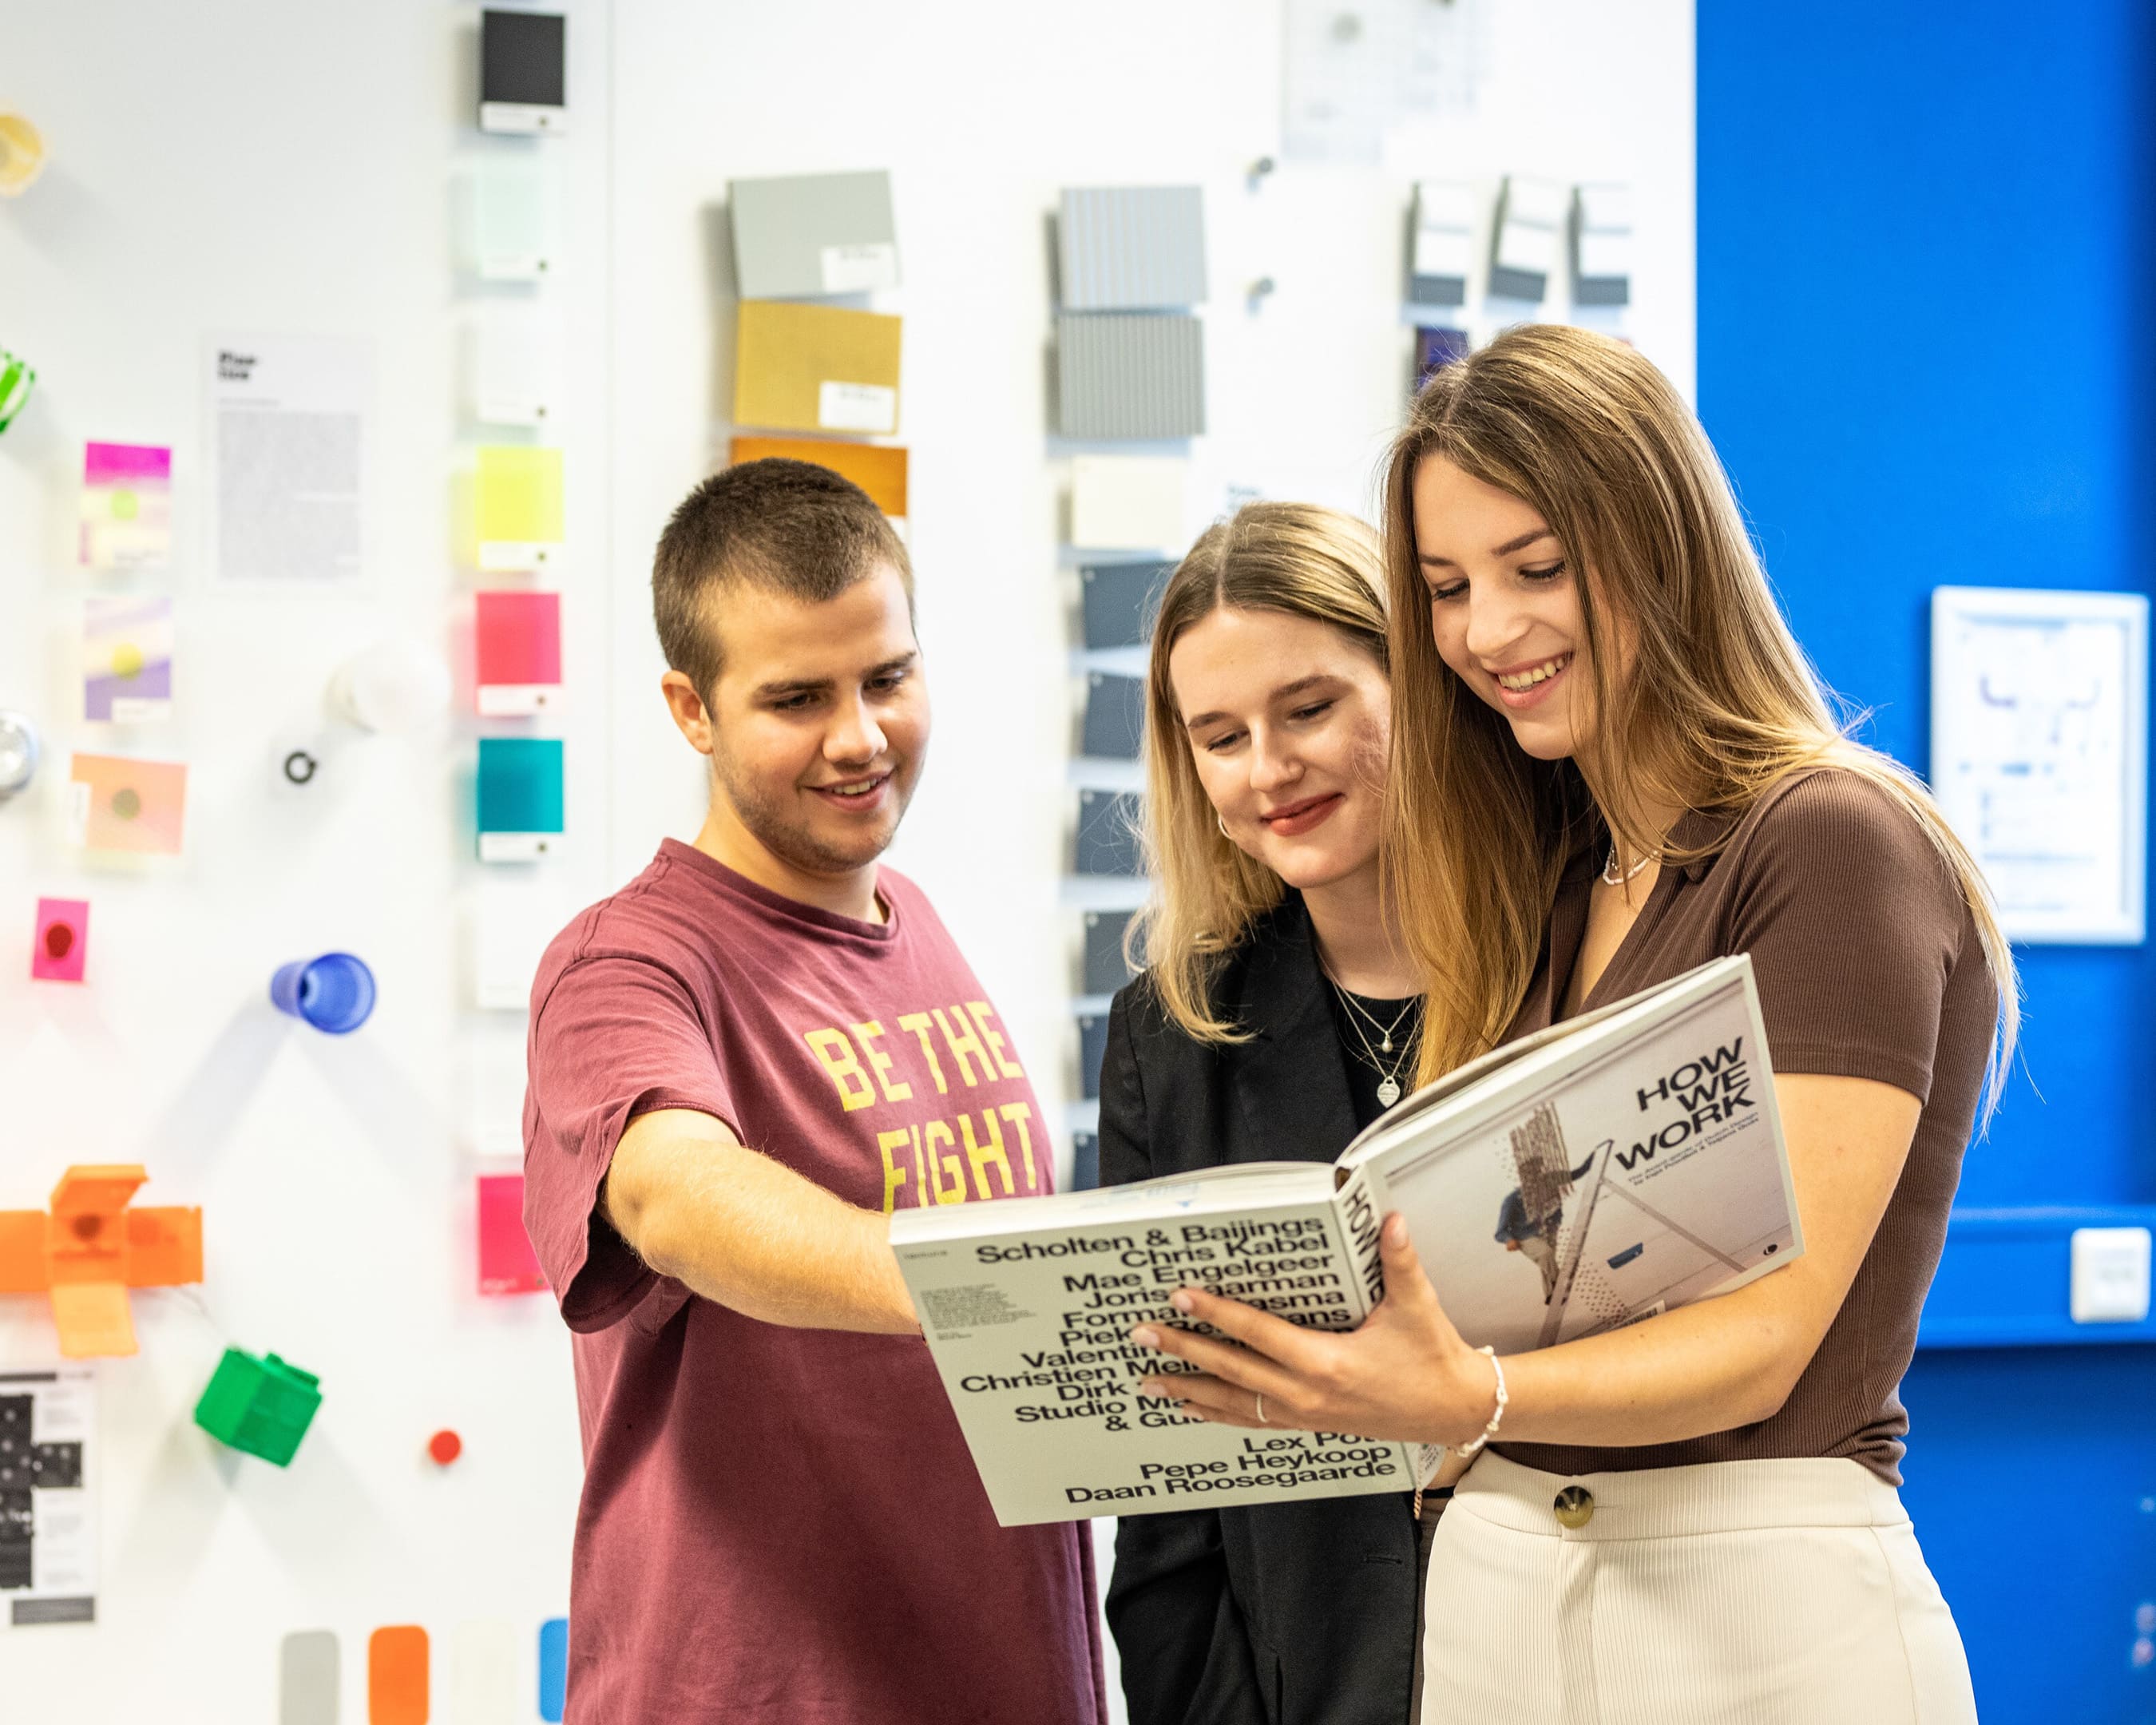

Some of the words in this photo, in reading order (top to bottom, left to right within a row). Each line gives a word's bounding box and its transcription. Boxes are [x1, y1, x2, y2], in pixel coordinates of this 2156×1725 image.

[804, 1019, 914, 1112] BE
[897, 1001, 1024, 1094] THE
[1637, 1036, 1743, 1112] HOW
[1676, 1060, 1750, 1112] WE
[1615, 1085, 1756, 1171] WORK
[877, 1101, 1036, 1215] FIGHT
[1343, 1181, 1382, 1255] HOW
[976, 1235, 1135, 1264] Scholten
[1145, 1228, 1171, 1247] &
[1180, 1217, 1325, 1243] Baijings
[1120, 1243, 1215, 1267] Chris
[1225, 1231, 1330, 1258] Kabel
[1063, 1273, 1142, 1292] Mae
[1152, 1254, 1334, 1283] Engelgeer
[1084, 1285, 1170, 1309] Joris
[1178, 1273, 1341, 1296] aarman
[1021, 1342, 1163, 1368] Valentin
[1060, 1326, 1132, 1348] Piek
[960, 1364, 1117, 1393] Christien
[1056, 1380, 1131, 1402] Dirk
[1015, 1398, 1128, 1422] Studio
[1104, 1414, 1132, 1432] &
[1139, 1460, 1229, 1480] Pepe
[1237, 1446, 1393, 1471] Heykoop
[1242, 1437, 1306, 1453] Lex
[1065, 1484, 1157, 1504] Daan
[1164, 1461, 1397, 1495] Roosegaarde
